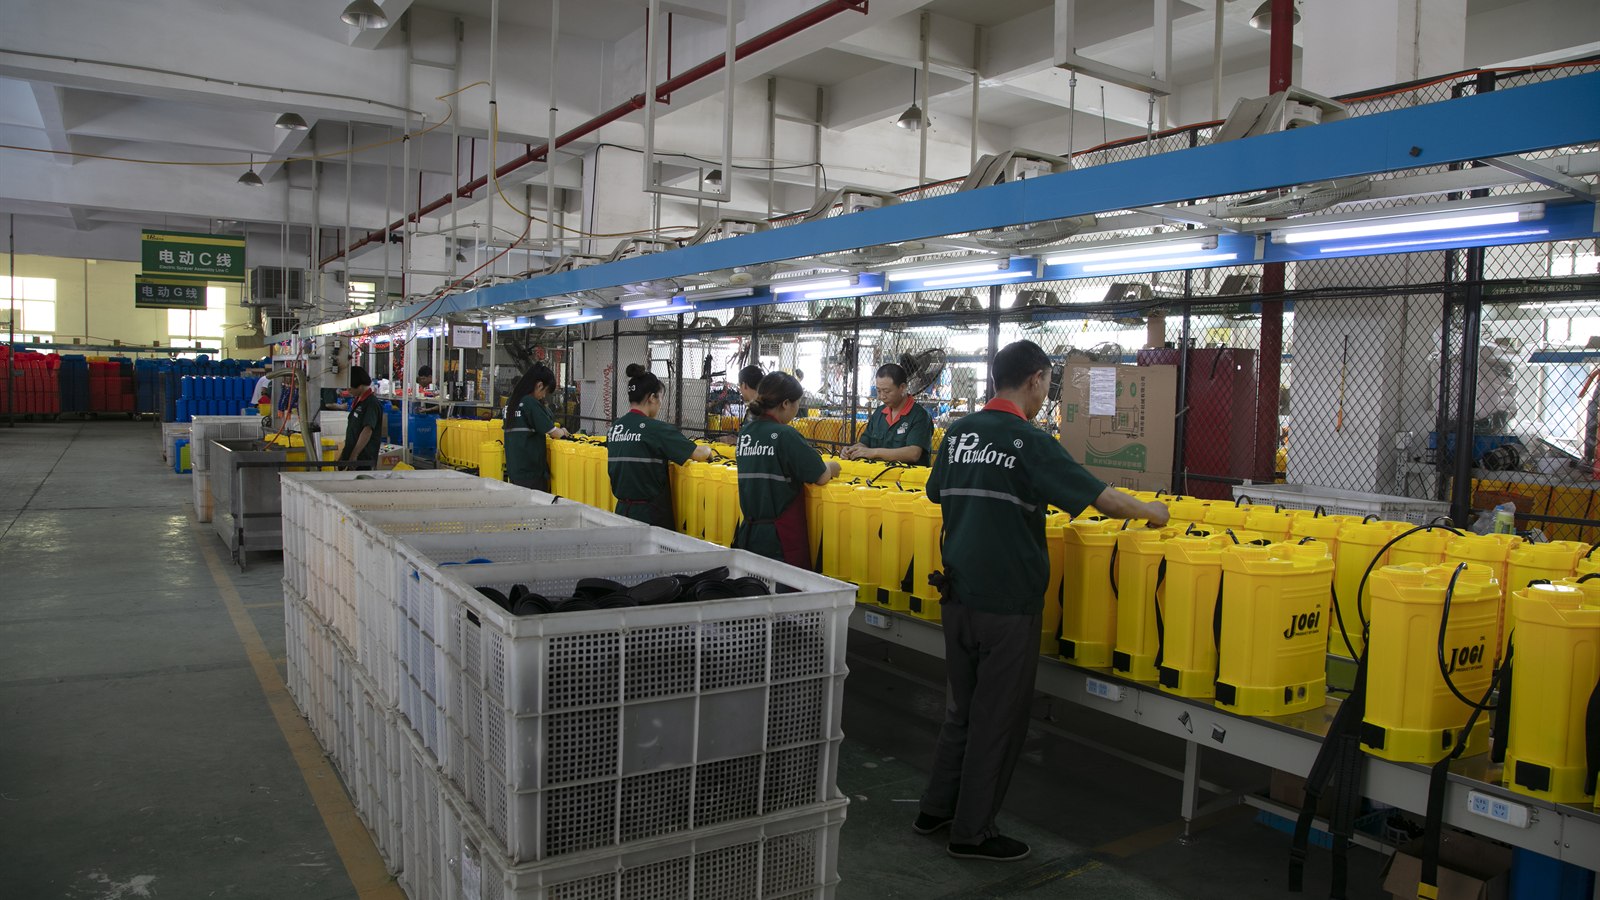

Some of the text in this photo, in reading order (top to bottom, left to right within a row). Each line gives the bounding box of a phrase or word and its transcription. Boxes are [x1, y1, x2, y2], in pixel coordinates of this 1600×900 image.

[159, 249, 232, 268] 电动C线
[142, 285, 198, 299] 电动G线
[611, 424, 642, 442] Pandora
[739, 434, 775, 456] Pandora
[954, 432, 1017, 470] Pandora
[1283, 610, 1320, 640] JOGI
[1446, 644, 1484, 675] JOGI
